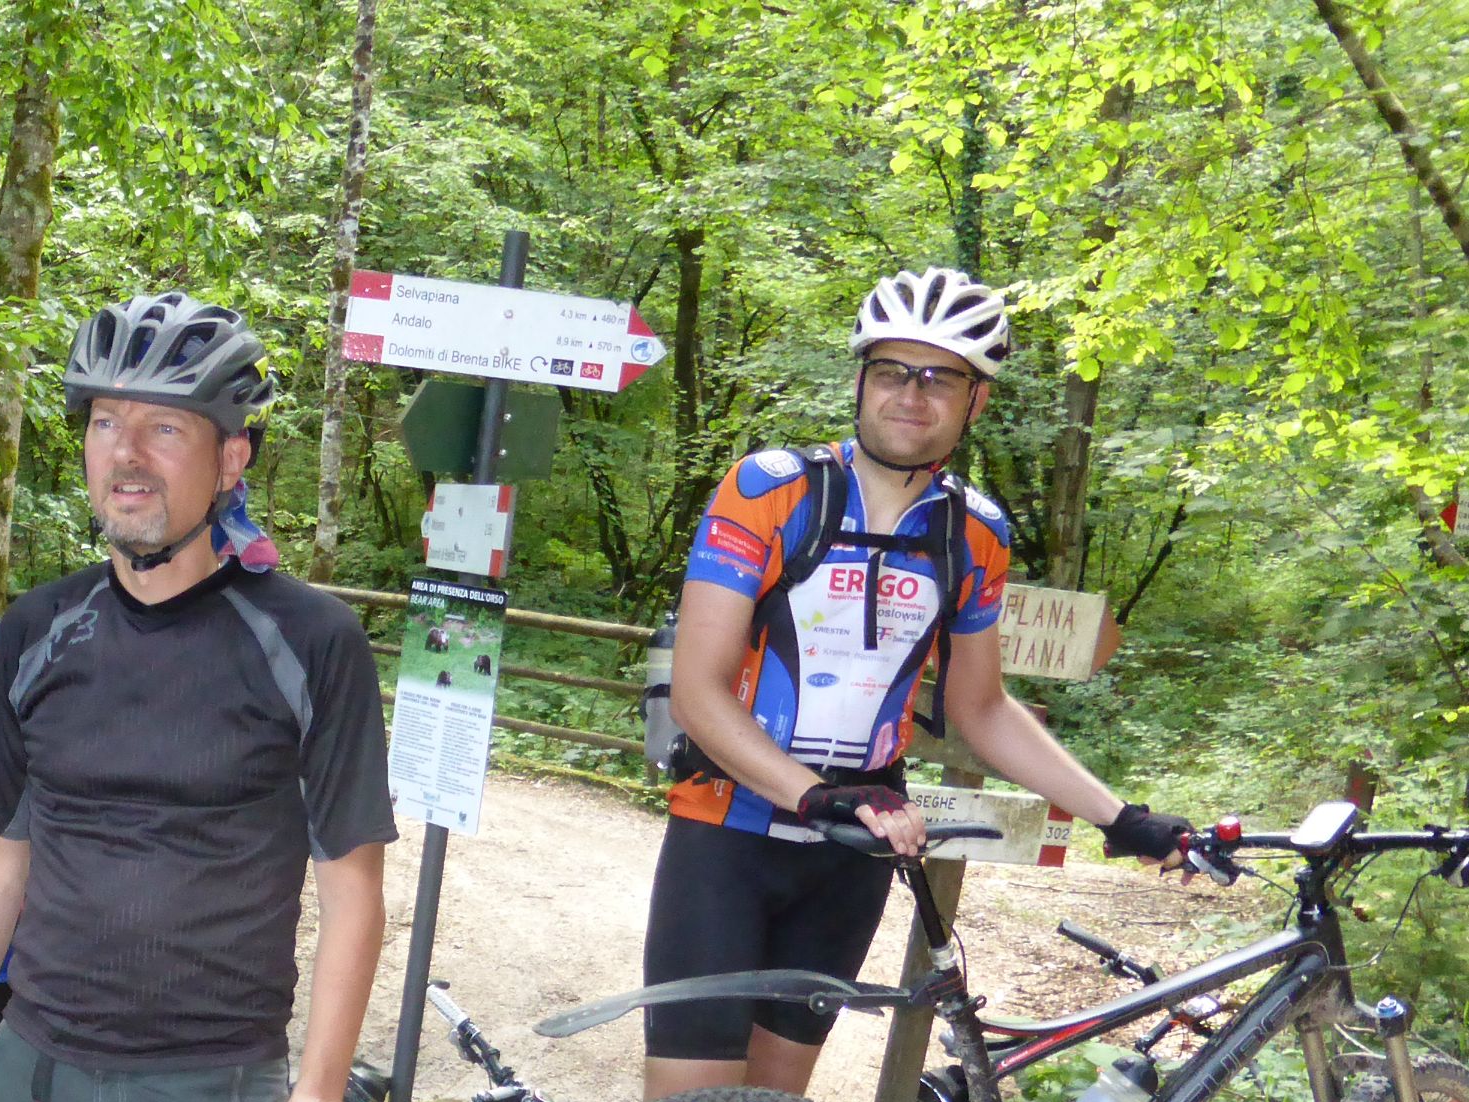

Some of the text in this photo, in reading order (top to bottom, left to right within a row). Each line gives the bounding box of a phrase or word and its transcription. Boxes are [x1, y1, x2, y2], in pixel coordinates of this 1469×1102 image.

[396, 284, 460, 305] Selvapiana
[391, 312, 433, 329] Andalo
[575, 312, 588, 321] km
[570, 339, 584, 348] km
[388, 342, 522, 371] Dolomiti di Brenta BIKE
[828, 567, 919, 600] ERGO
[412, 580, 504, 605] AREA DI PRESENZA DELL'ORSO
[876, 608, 926, 622] oslowski
[914, 794, 957, 811] SEGHE
[1045, 826, 1070, 841] 302
